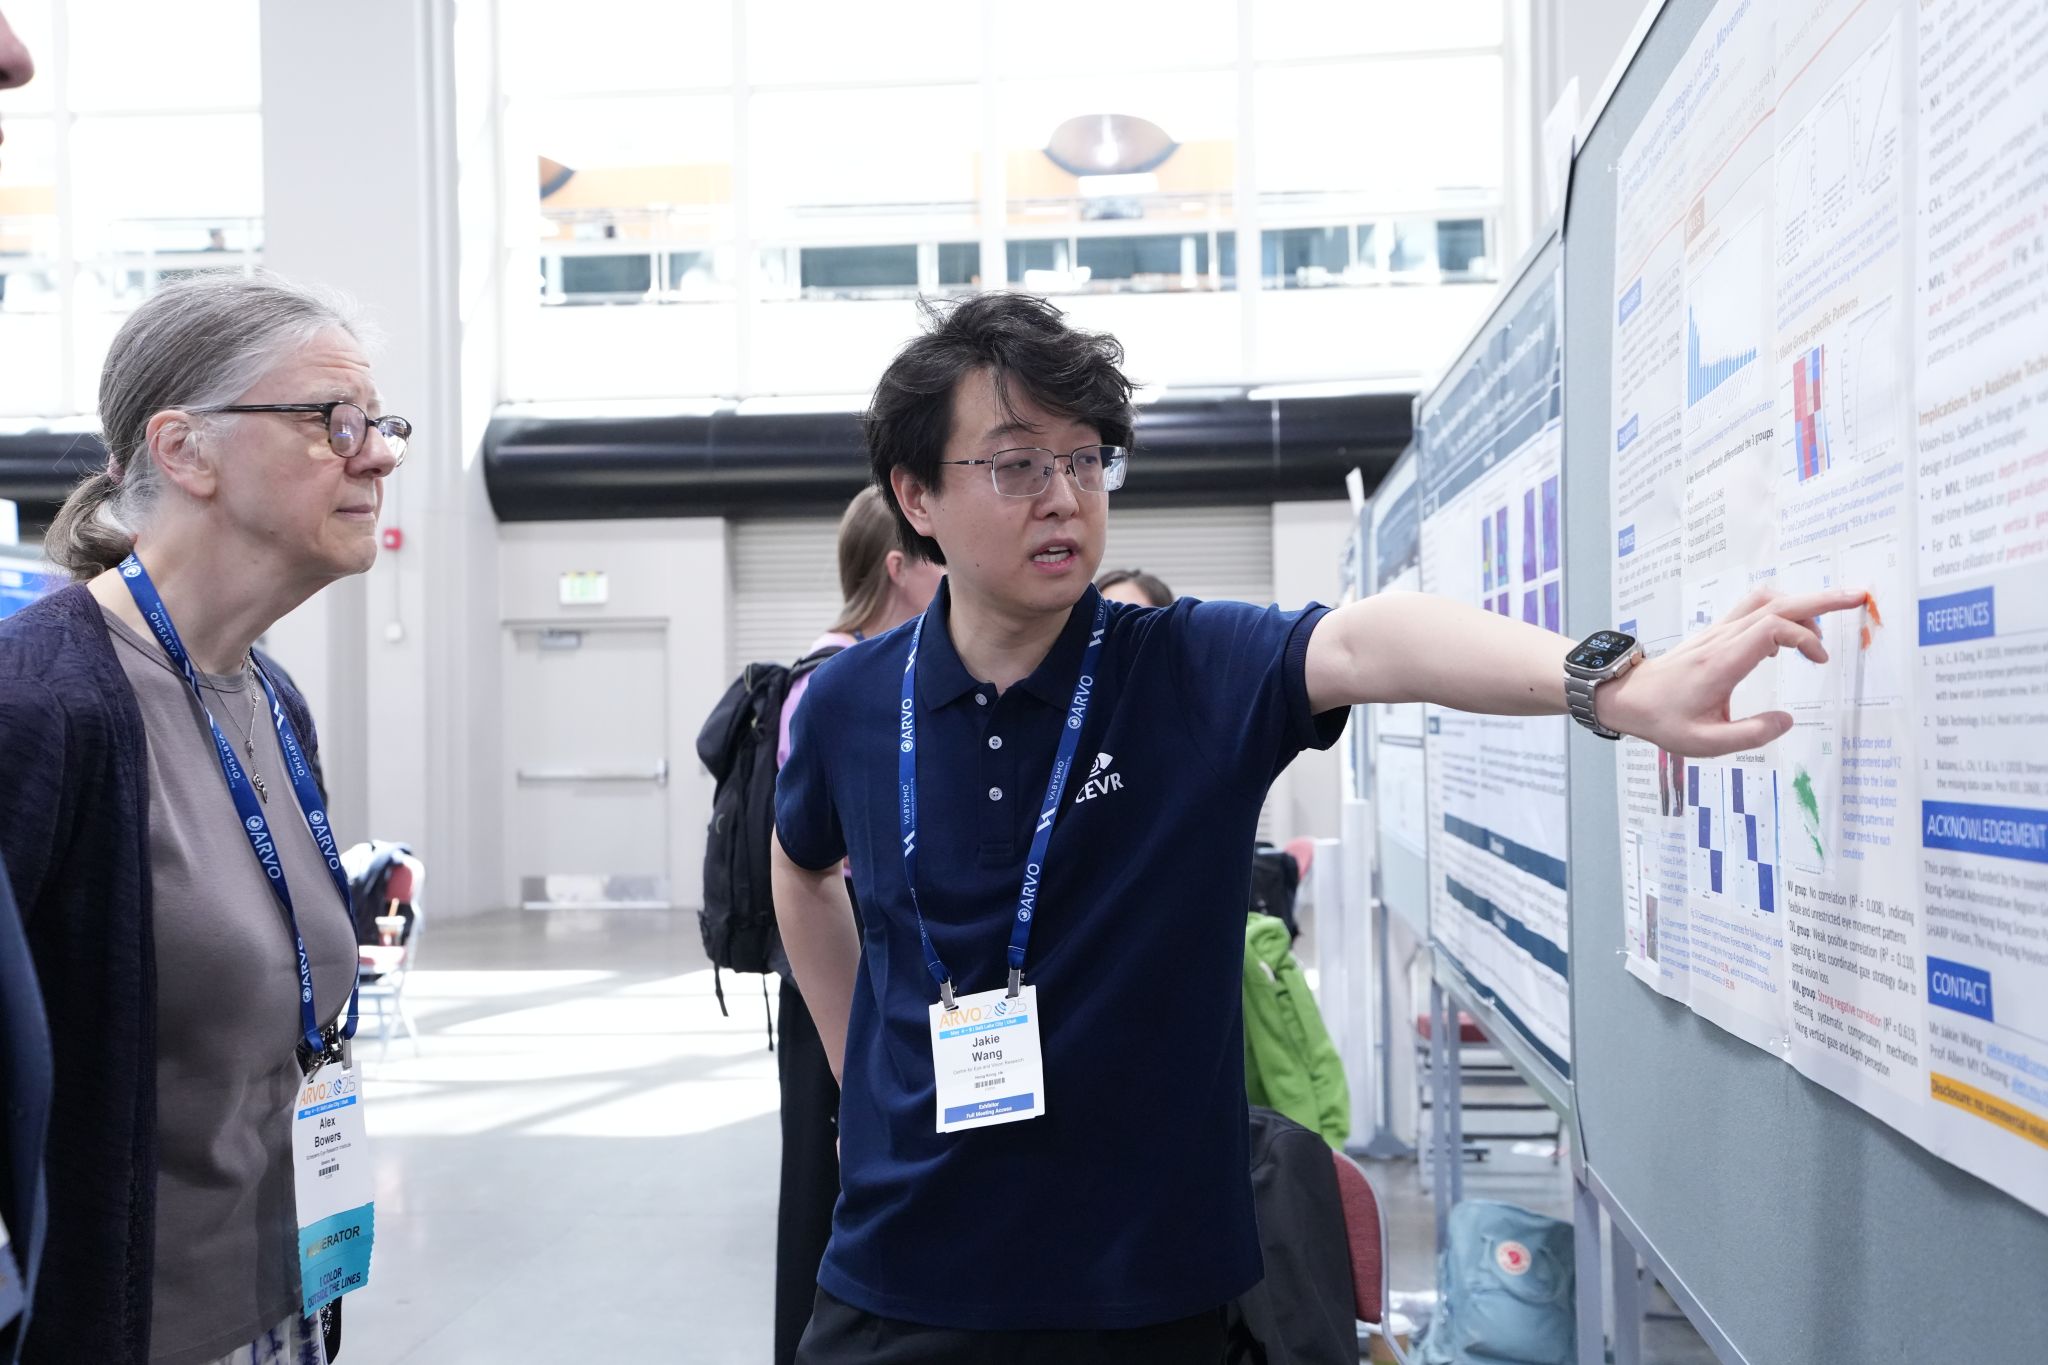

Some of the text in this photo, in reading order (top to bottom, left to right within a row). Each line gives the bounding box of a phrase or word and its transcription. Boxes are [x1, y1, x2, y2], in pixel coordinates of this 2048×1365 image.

[1716, 0, 1751, 50] Movemen
[1832, 296, 1860, 320] Patterns
[1919, 396, 1968, 426] Implications
[1970, 387, 1982, 402] for
[1920, 460, 1942, 477] design
[1932, 487, 1942, 500] For
[1932, 540, 1943, 552] For
[1933, 561, 1961, 577] enhance
[1927, 602, 1990, 632] REFERENCES
[150, 612, 178, 656] VABYSMO
[1072, 675, 1093, 718] ARVO
[901, 698, 913, 740] ARVO
[219, 733, 241, 779] VABYSMO
[285, 734, 304, 776] VABYSMO
[1048, 760, 1064, 800] VABYSMO
[1927, 814, 2047, 848] ACKNOWLEDGEMENT
[250, 832, 281, 879] ARVO
[313, 826, 340, 870] ARVO
[1924, 860, 1938, 874] This
[1940, 864, 1961, 880] project
[1021, 863, 1040, 909] ARVO
[1925, 884, 1942, 899] Kong
[1802, 905, 1810, 917] and
[1812, 909, 1840, 926] unrestricted
[1842, 917, 1851, 930] eye
[1853, 920, 1880, 937] movement
[1810, 886, 1816, 898] No
[1818, 890, 1846, 905] correlation
[1888, 904, 1914, 927] indicating
[1926, 904, 1969, 923] administered
[1812, 928, 1826, 942] Weak
[1828, 934, 1848, 950] positive
[1850, 941, 1878, 959] correlation
[298, 937, 310, 986] ARVO
[1805, 966, 1818, 981] vision
[1817, 948, 1826, 963] less
[1828, 955, 1858, 974] coordinated
[1859, 966, 1870, 980] gaze
[1872, 969, 1895, 990] strategy
[1898, 976, 1909, 993] due
[1932, 971, 1986, 1006] CONTACT
[1817, 990, 1834, 1010] Strong
[1835, 998, 1856, 1015] negative
[1856, 1008, 1882, 1027] correlation
[972, 1034, 1000, 1047] Jakie
[972, 1049, 1003, 1062] Wang
[1810, 1029, 1826, 1044] vertical
[1827, 1036, 1838, 1050] gaze
[1839, 1043, 1849, 1055] and
[1850, 1045, 1864, 1062] depth
[1864, 1054, 1890, 1077] perception
[1886, 1044, 1918, 1067] mechanism
[976, 1110, 994, 1118] Meeting
[979, 1102, 999, 1110] Exhibitor
[320, 1117, 336, 1130] Alex
[314, 1132, 341, 1148] Bowers
[306, 1226, 360, 1258] ERATOR
[322, 1267, 342, 1284] COLOR
[329, 1281, 340, 1294] THE
